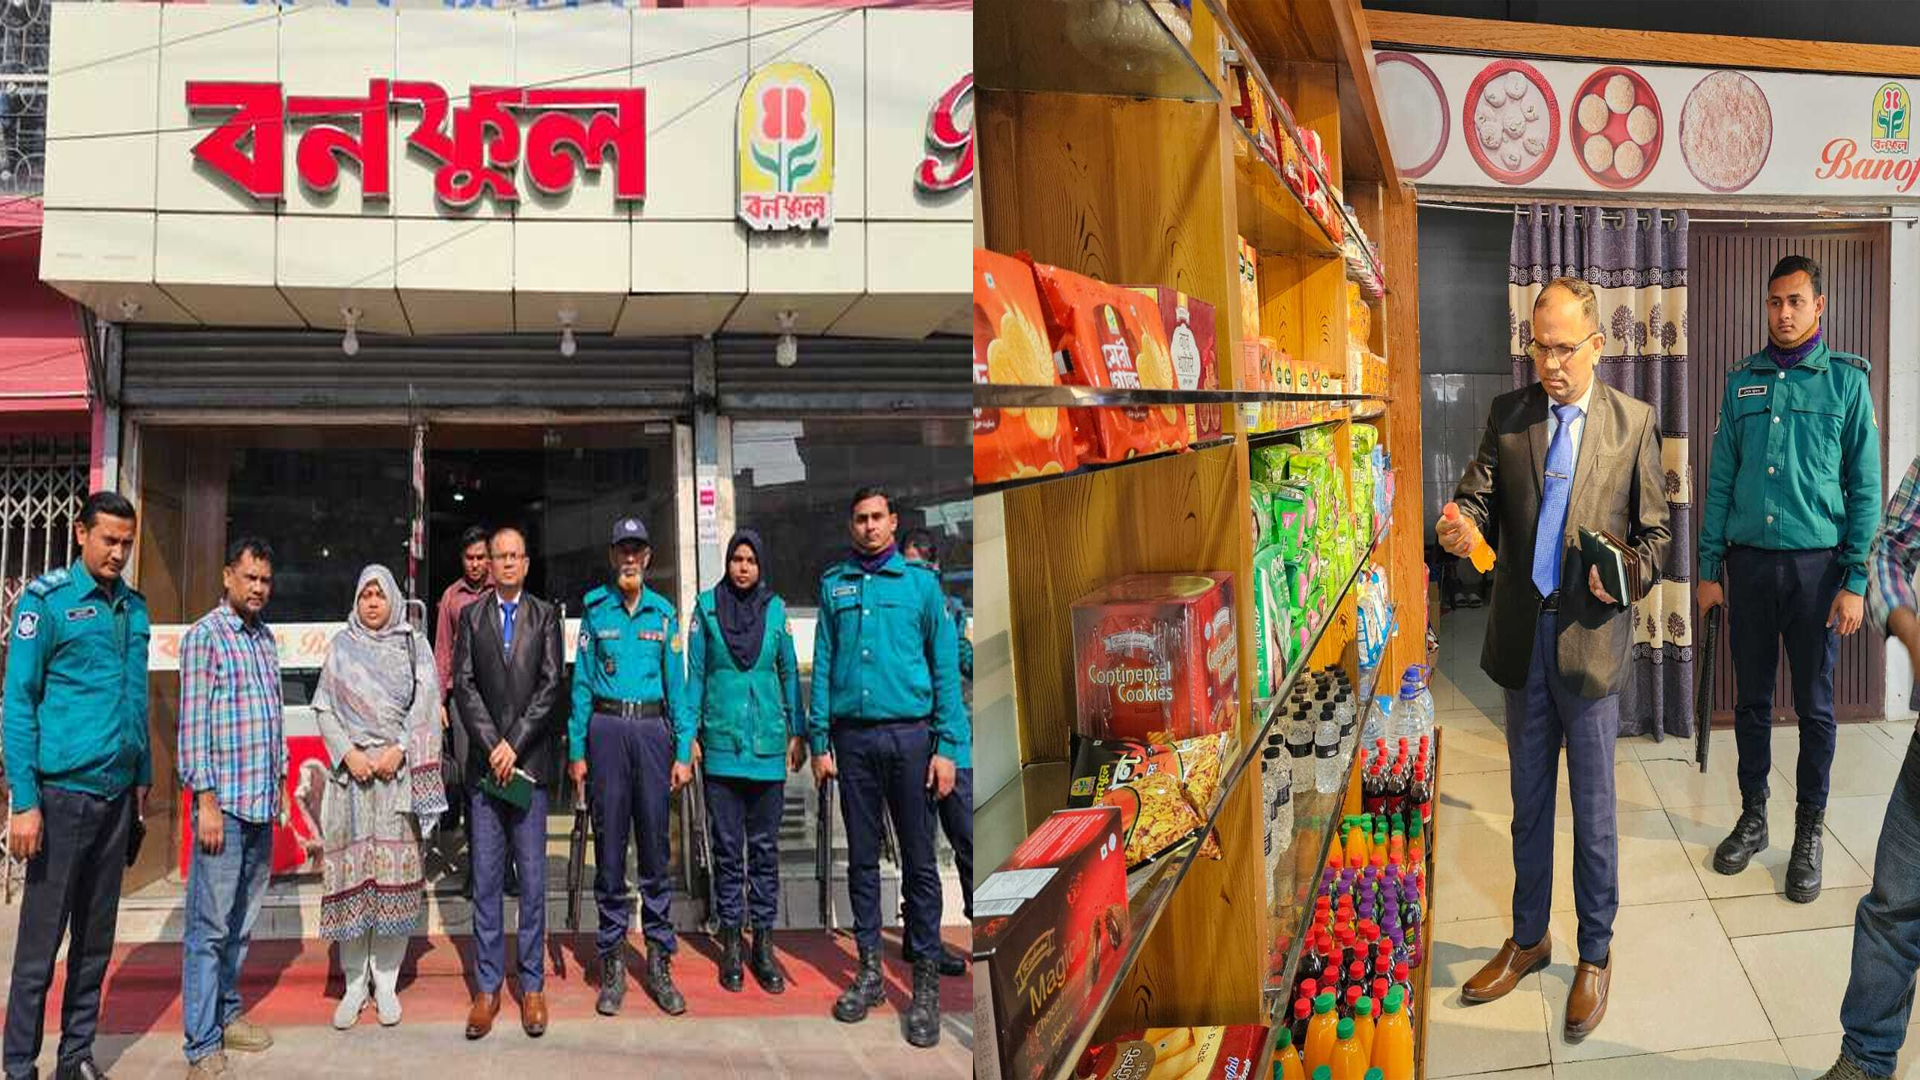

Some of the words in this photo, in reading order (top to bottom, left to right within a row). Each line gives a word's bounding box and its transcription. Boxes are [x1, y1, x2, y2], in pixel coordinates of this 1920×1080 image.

[185, 78, 647, 205] বনফুল
[1873, 140, 1908, 152] বনফুল
[742, 193, 825, 219] বনফুল
[1088, 661, 1172, 686] Continental
[1117, 683, 1174, 703] Cookies
